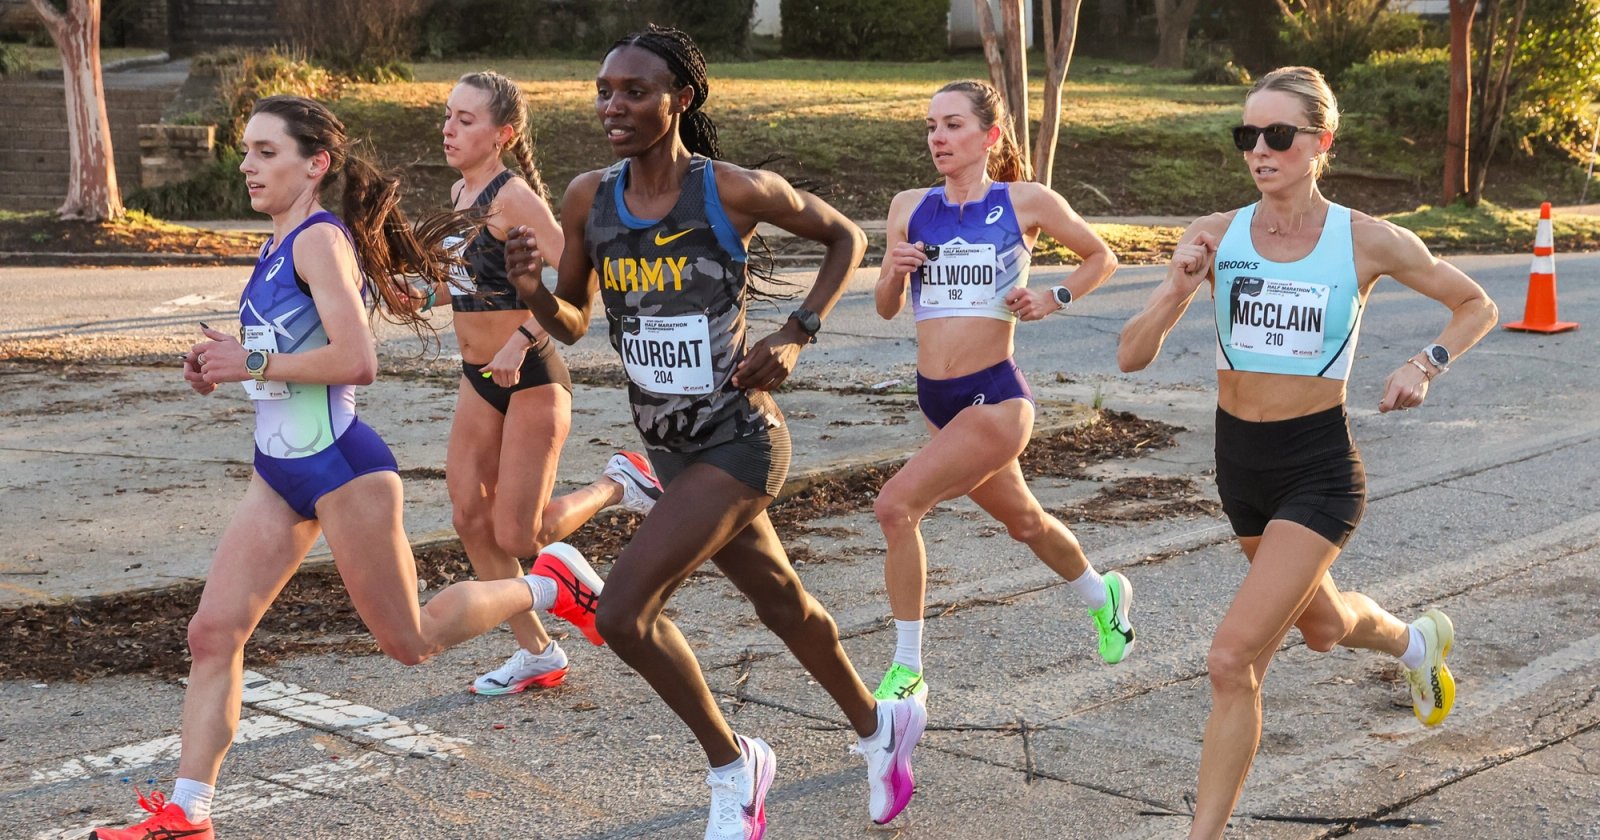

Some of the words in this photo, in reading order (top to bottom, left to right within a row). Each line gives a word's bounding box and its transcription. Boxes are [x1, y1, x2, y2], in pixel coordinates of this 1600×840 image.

[603, 256, 688, 292] ARMY
[922, 264, 993, 286] ELLWOOD
[1218, 260, 1260, 271] BROOKS
[948, 288, 963, 301] 192
[1234, 300, 1323, 333] MCCLAIN
[1265, 331, 1284, 347] 210
[623, 338, 703, 369] KURGAT
[654, 370, 673, 384] 204
[1431, 666, 1442, 709] BROOKS
